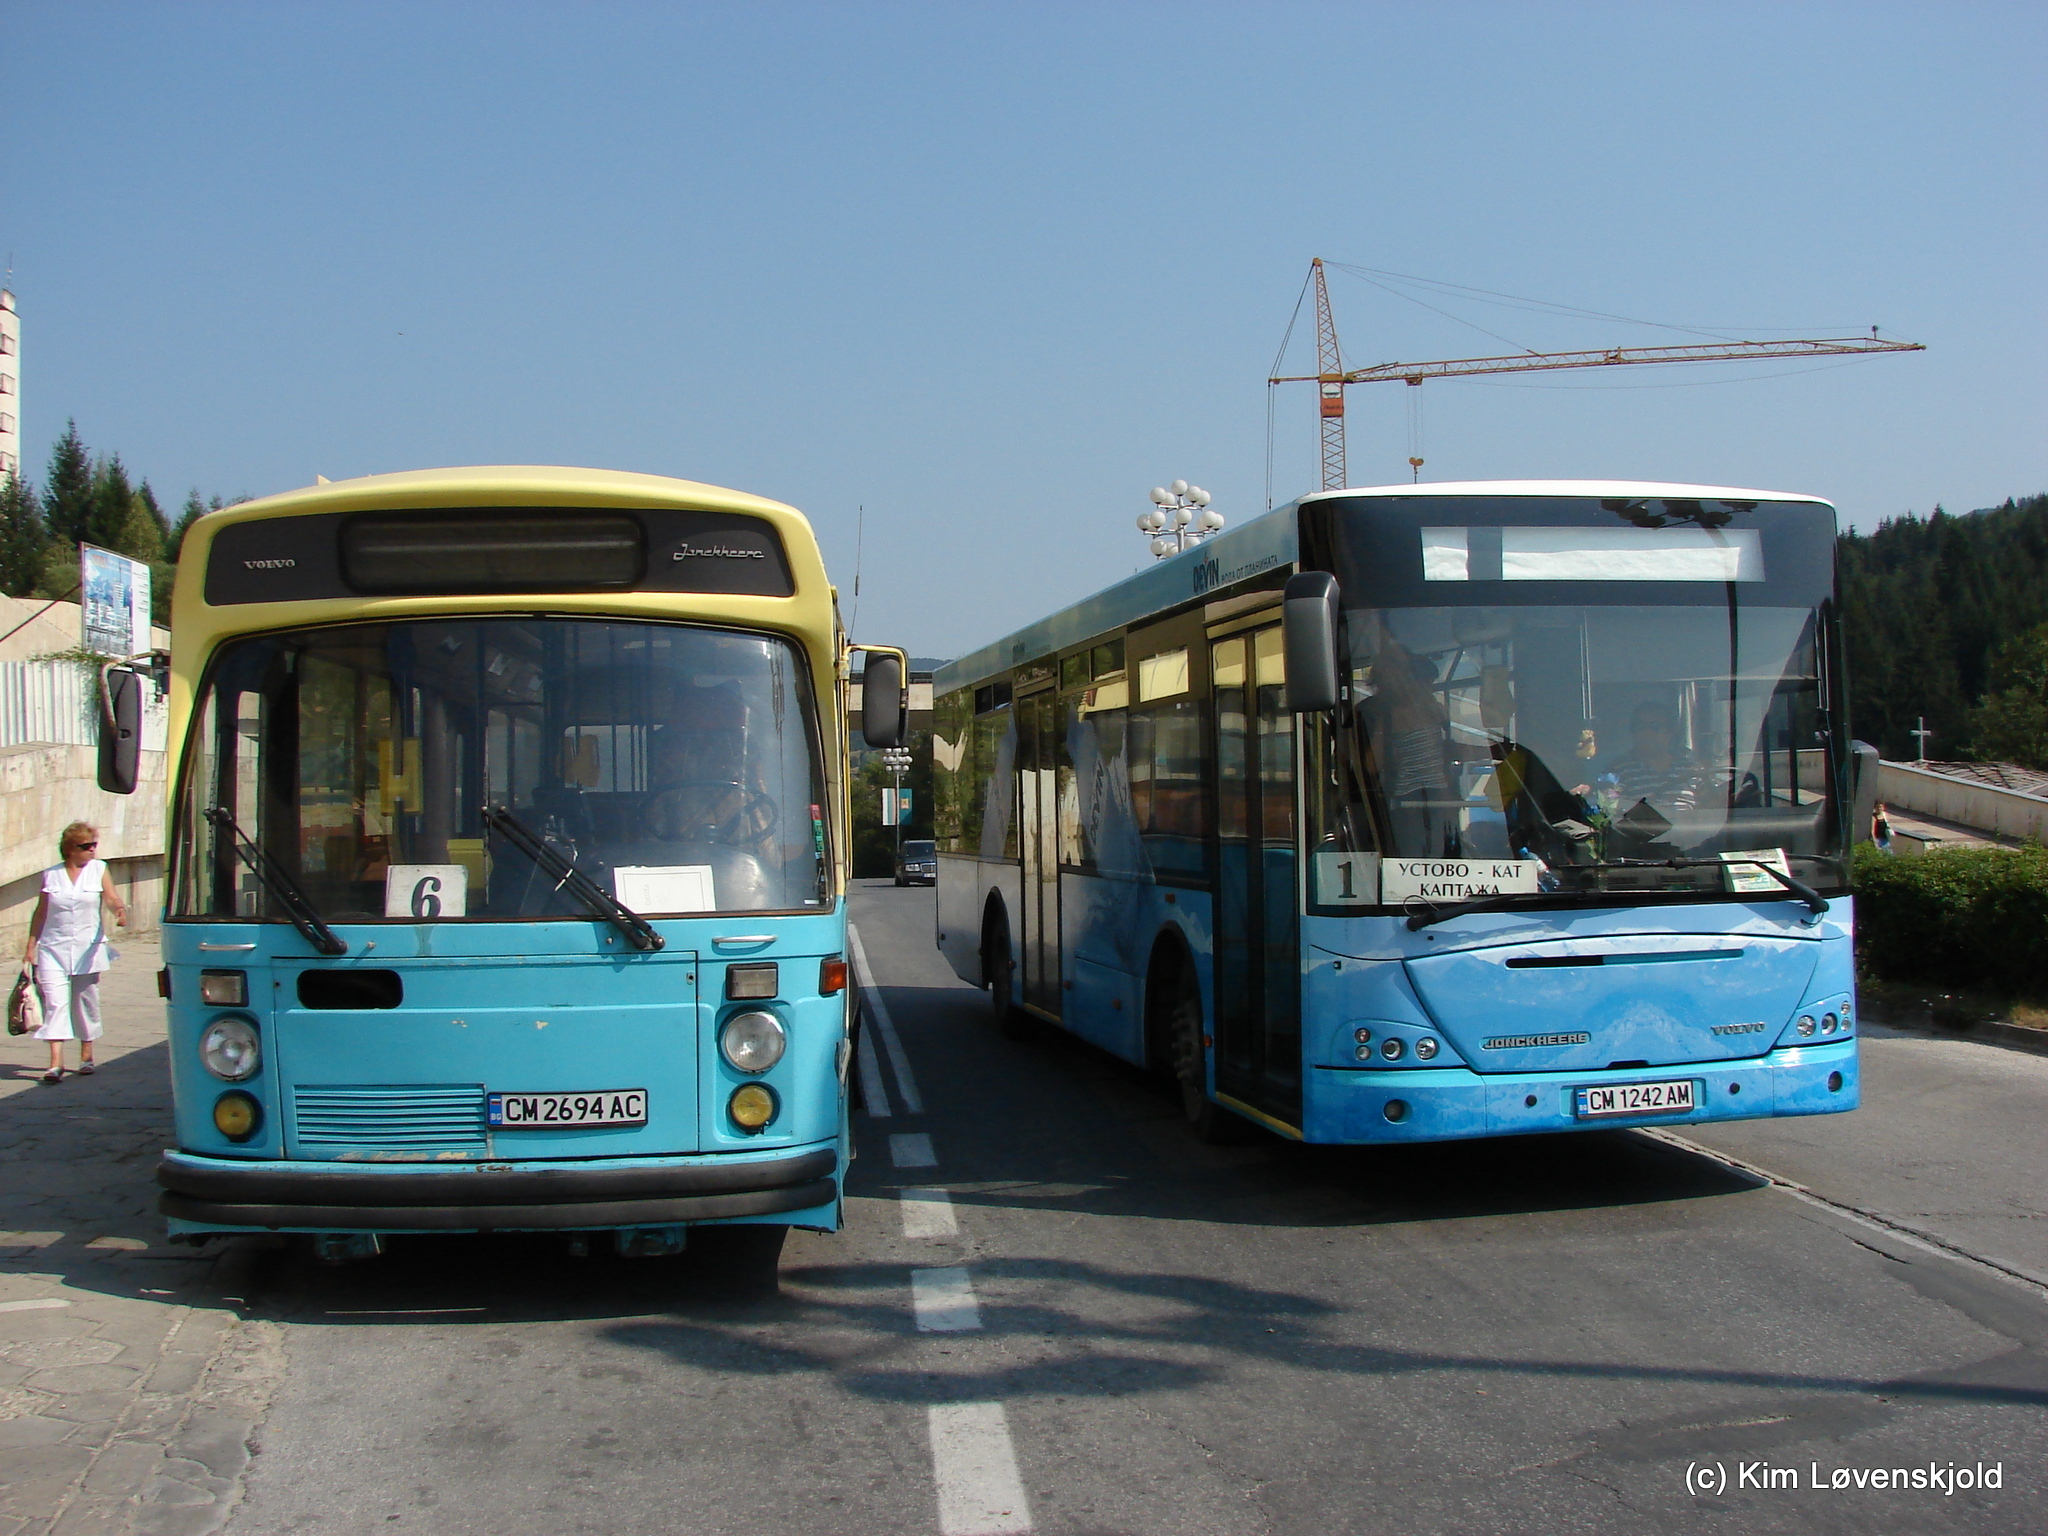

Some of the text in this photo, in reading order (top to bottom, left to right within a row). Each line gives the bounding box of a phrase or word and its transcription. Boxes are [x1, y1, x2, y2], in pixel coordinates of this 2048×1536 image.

[243, 559, 296, 569] VOLVO
[1193, 557, 1219, 593] DEVIN
[1236, 567, 1244, 580] ОТ
[1398, 862, 1470, 878] УСТОВО
[1492, 864, 1523, 878] КАТ
[1337, 861, 1358, 899] 1
[410, 876, 443, 917] 6
[1420, 883, 1500, 897] КАПТАЖА
[1710, 1021, 1766, 1036] VOLVO
[1484, 1033, 1589, 1049] JONCKHEERE
